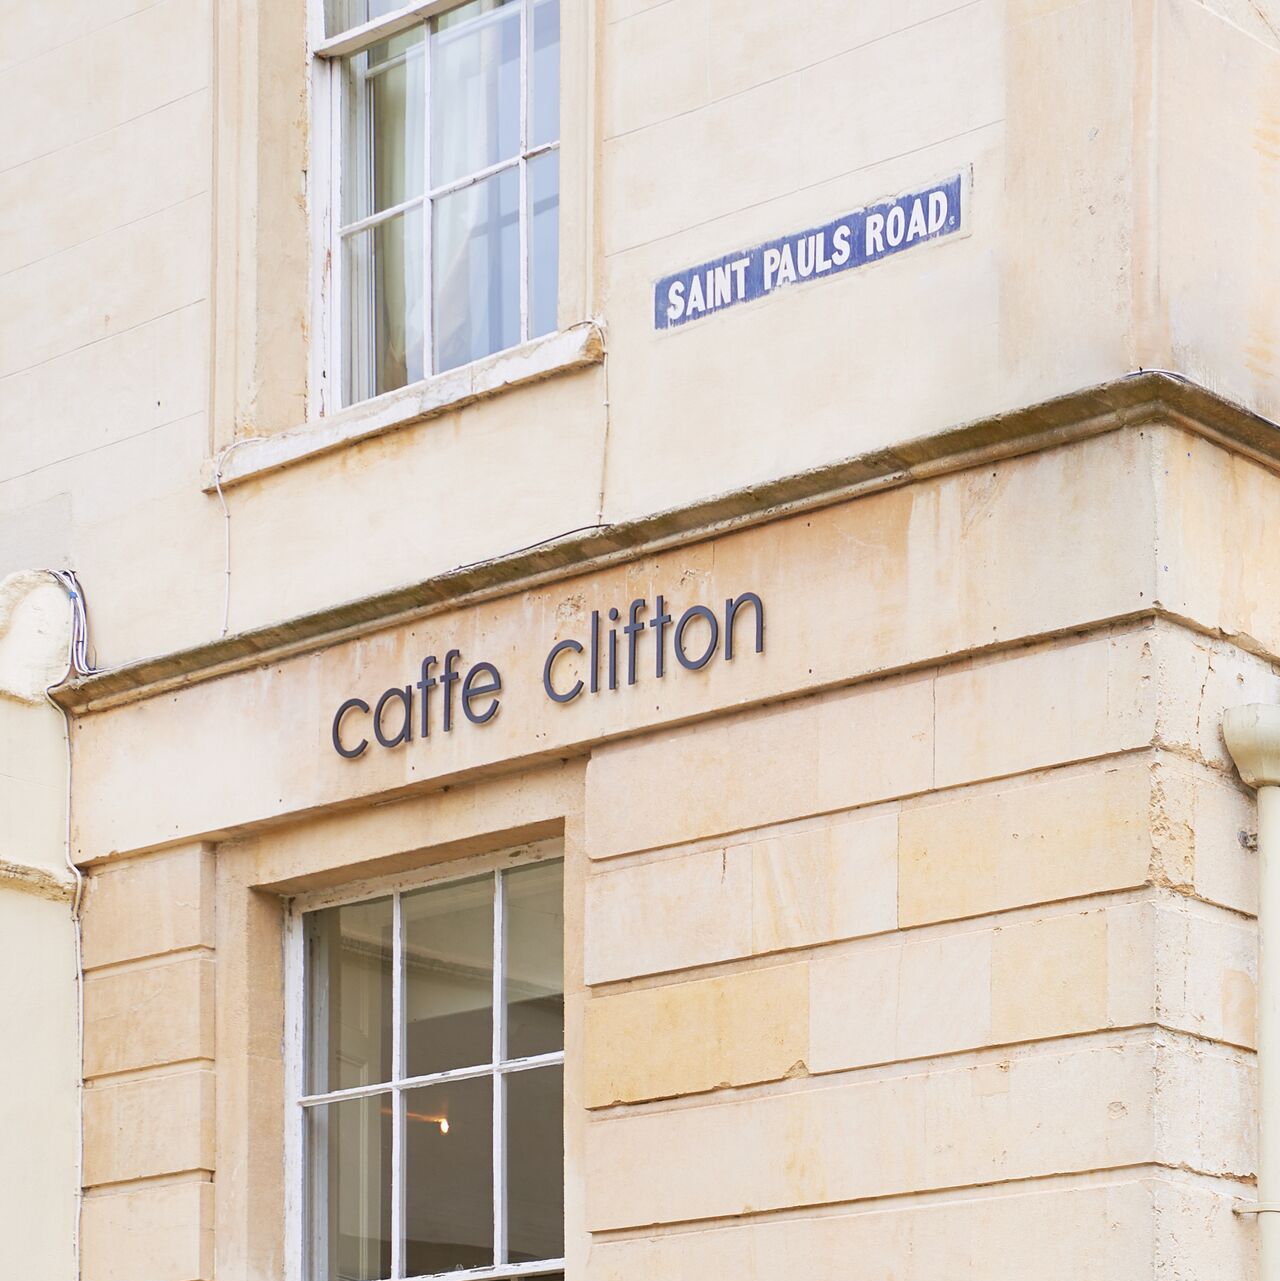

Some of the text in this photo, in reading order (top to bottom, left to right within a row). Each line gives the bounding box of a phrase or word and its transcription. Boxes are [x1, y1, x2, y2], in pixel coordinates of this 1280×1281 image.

[667, 256, 750, 320] SAINT
[763, 225, 852, 290] PAULS
[332, 592, 764, 758] caffe clifton
